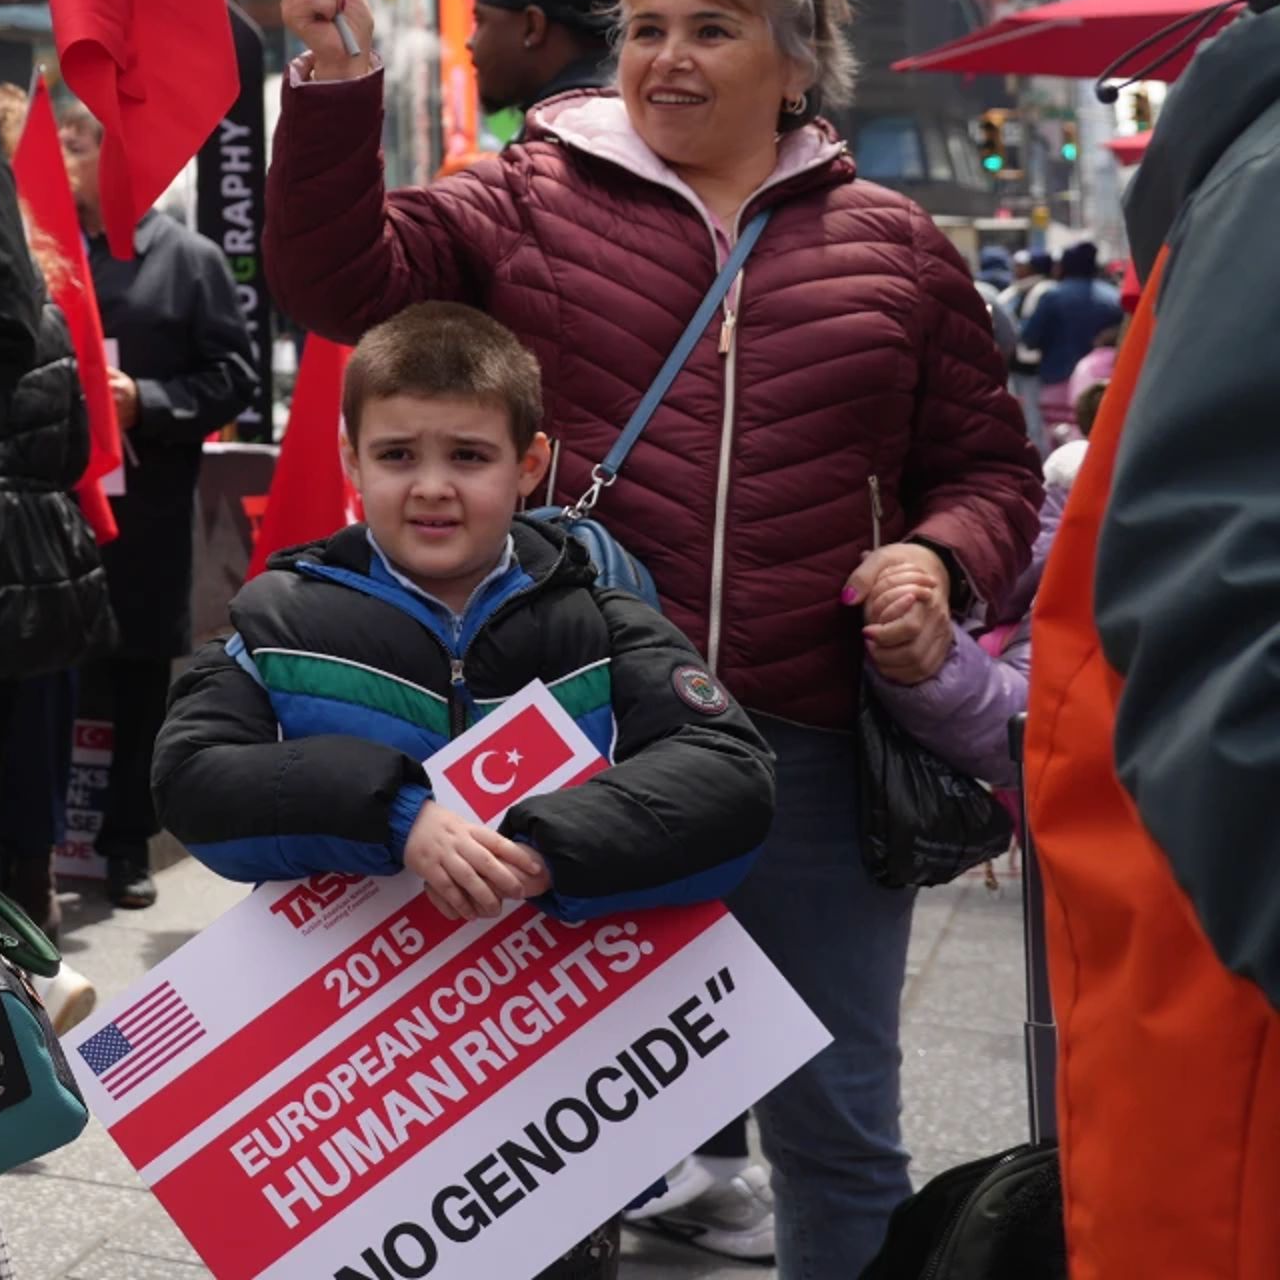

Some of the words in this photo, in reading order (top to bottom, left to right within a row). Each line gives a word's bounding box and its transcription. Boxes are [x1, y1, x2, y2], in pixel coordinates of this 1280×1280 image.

[230, 1005, 436, 1178] EUROPEAN
[429, 913, 567, 1024] COURT
[261, 1049, 470, 1230] HUMAN
[449, 921, 655, 1086] RIGHTS:
[324, 917, 426, 1009] 2015
